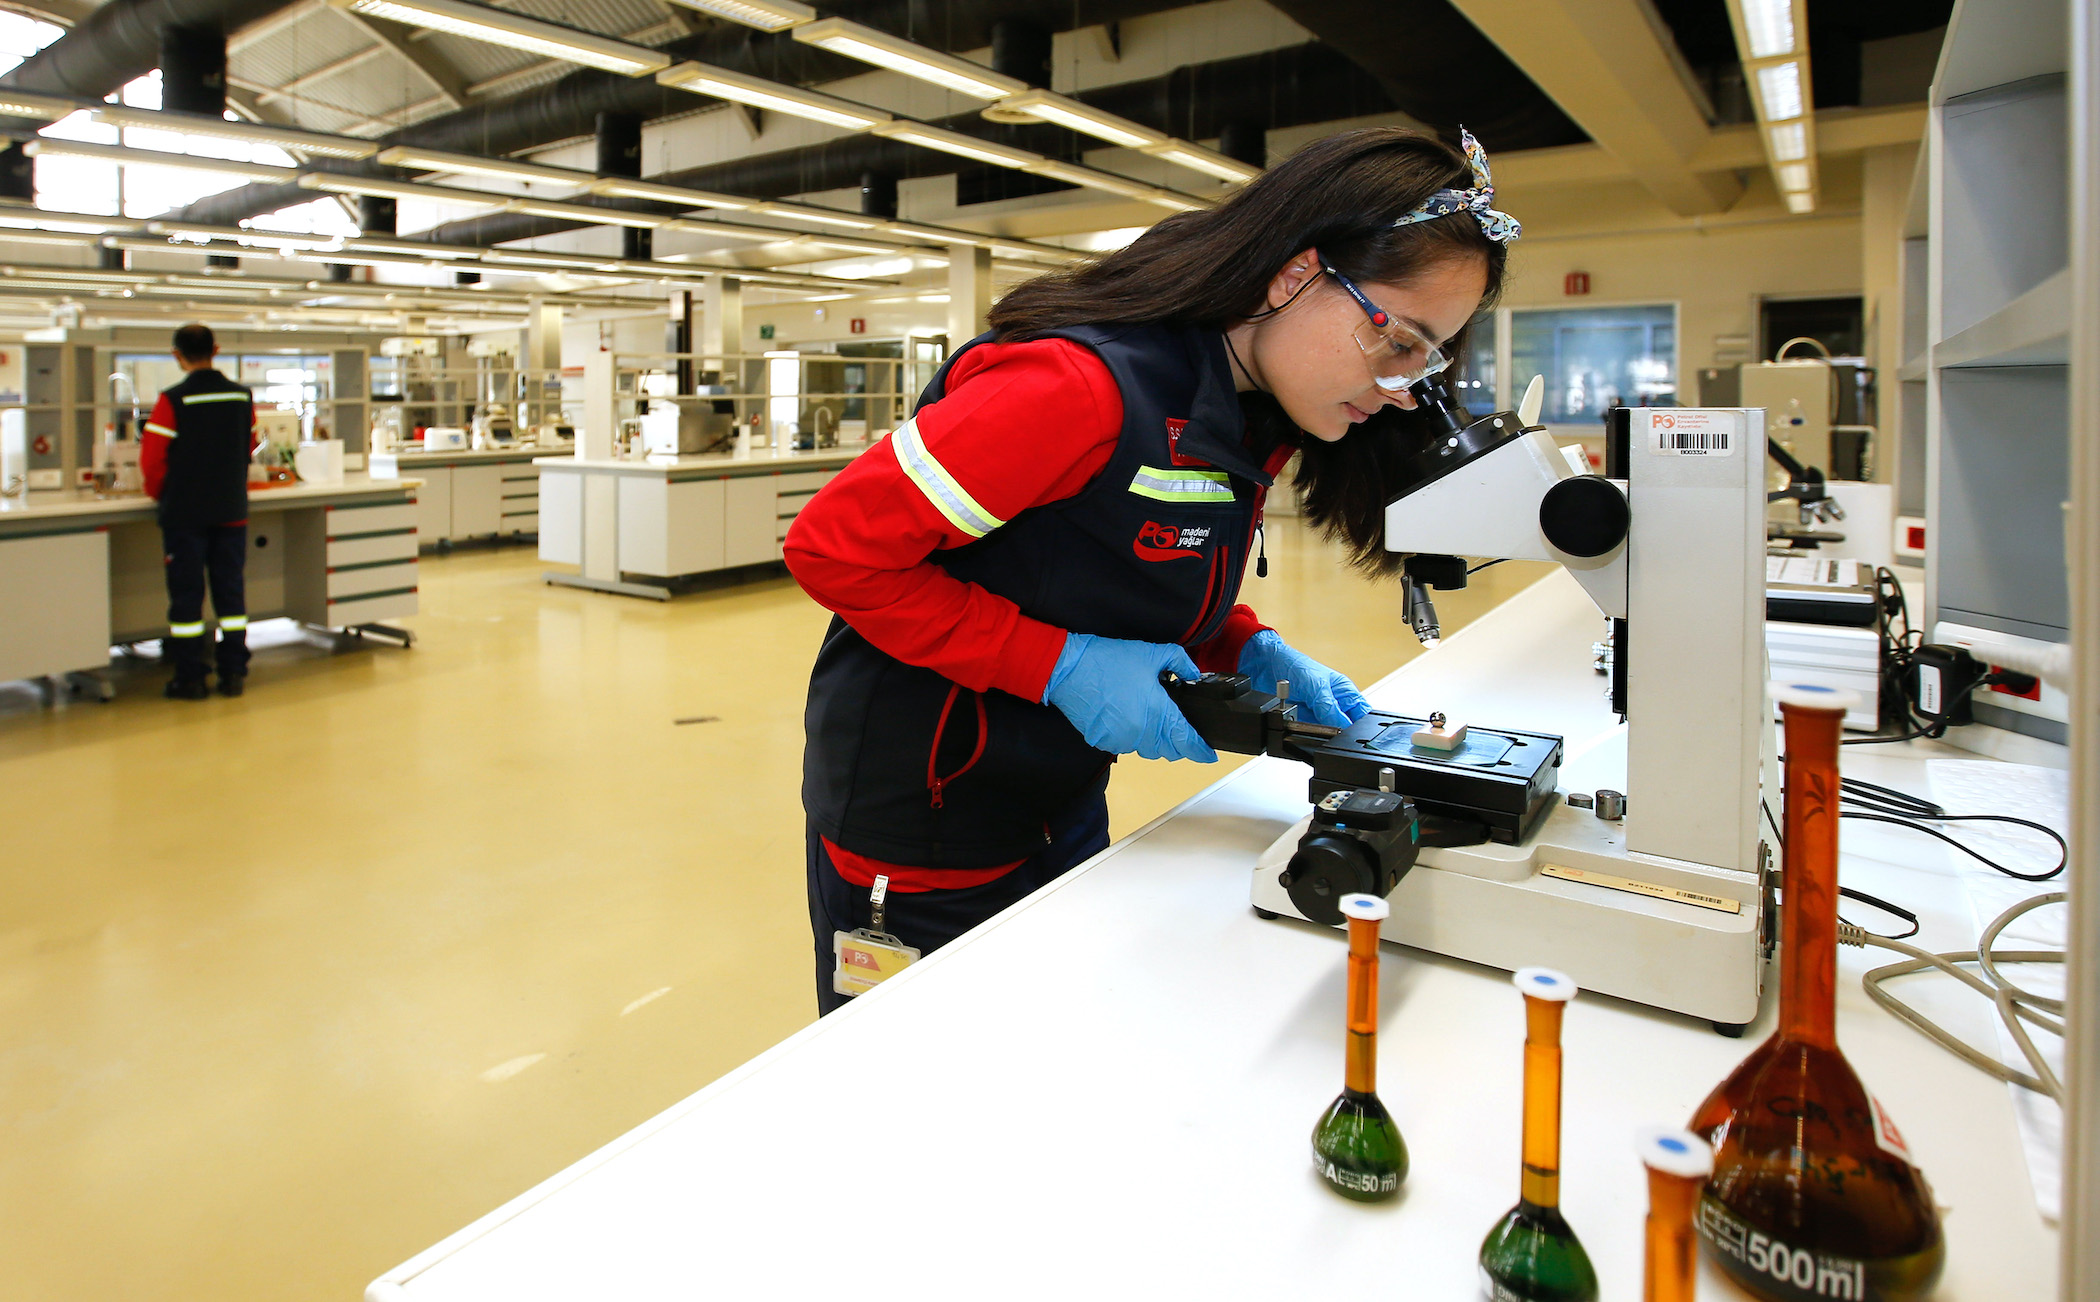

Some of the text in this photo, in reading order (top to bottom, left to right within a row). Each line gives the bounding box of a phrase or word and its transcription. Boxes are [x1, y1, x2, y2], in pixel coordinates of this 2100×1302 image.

[1181, 527, 1211, 537] madeni
[1177, 537, 1205, 548] yağlar
[1362, 1175, 1379, 1192] 50
